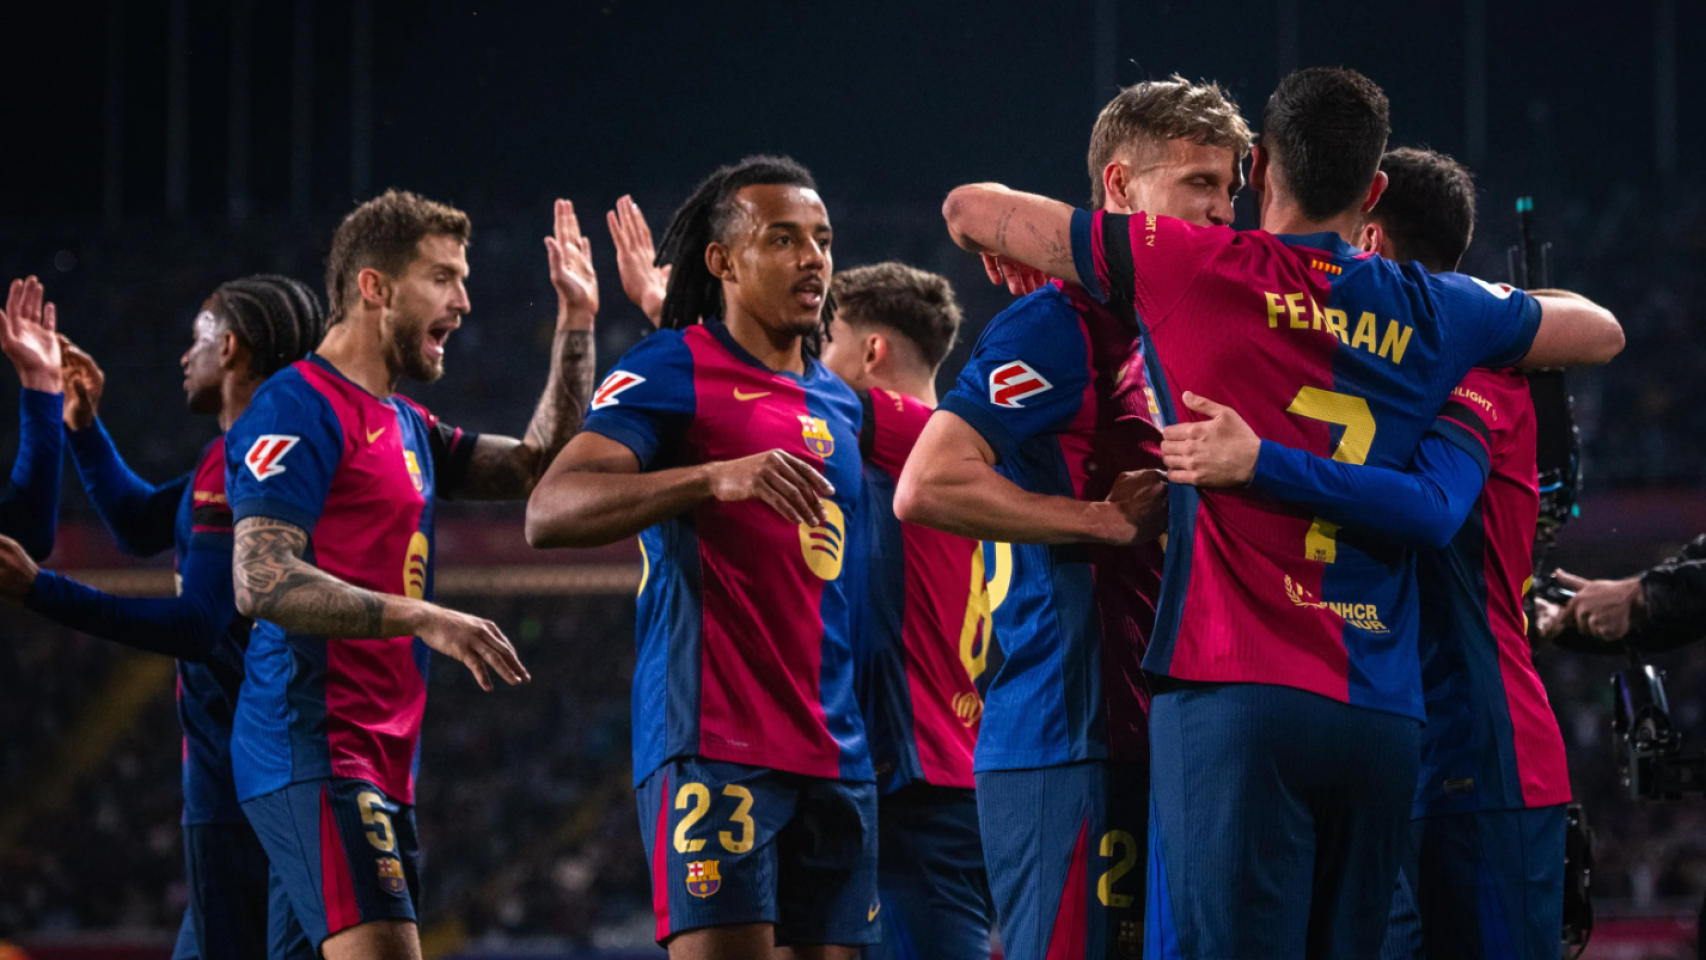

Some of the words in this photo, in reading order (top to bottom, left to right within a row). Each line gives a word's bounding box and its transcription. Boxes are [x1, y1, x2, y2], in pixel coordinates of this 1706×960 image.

[1264, 291, 1413, 364] FERRAN
[1286, 385, 1376, 564] 7
[1321, 602, 1378, 620] NHCR
[357, 791, 395, 852] 5
[673, 782, 755, 854] 23
